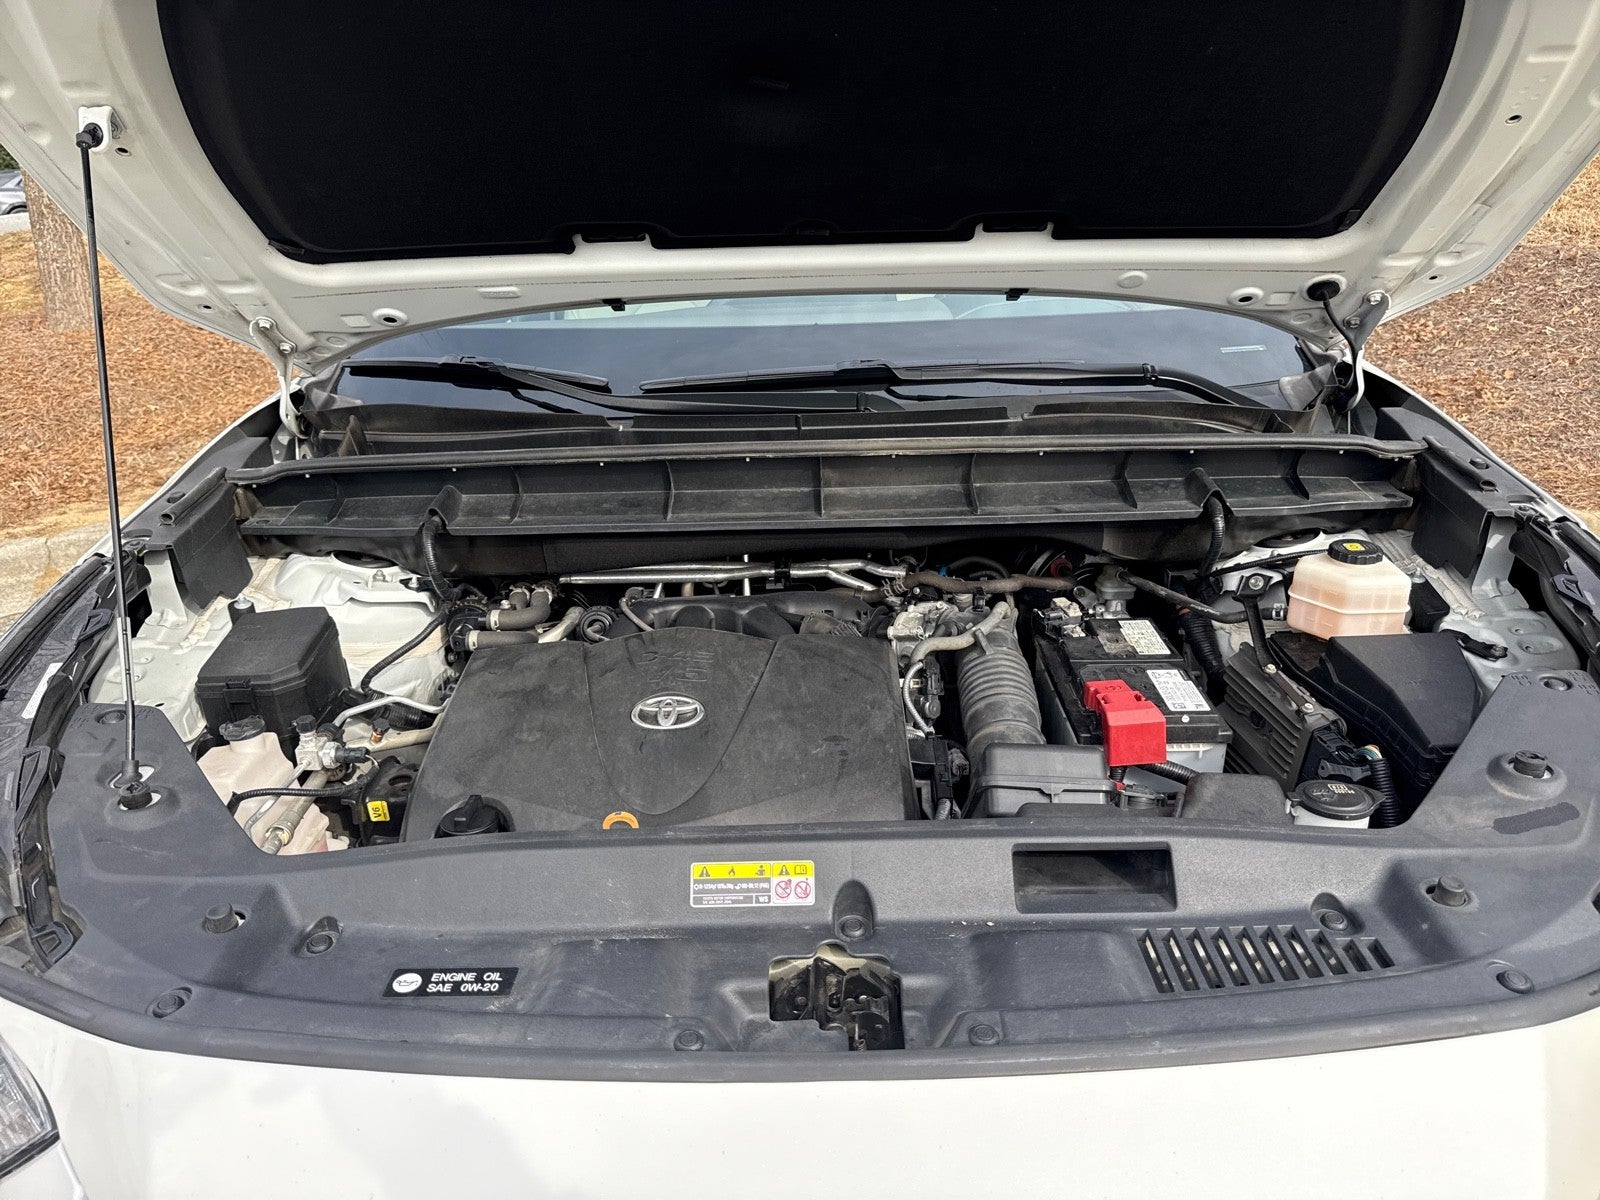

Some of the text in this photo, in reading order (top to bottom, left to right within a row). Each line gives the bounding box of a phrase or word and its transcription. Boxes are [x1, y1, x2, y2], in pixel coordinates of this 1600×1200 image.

[372, 807, 382, 818] V6
[431, 972, 503, 981] ENGINE OIL
[427, 982, 499, 992] SAE 0W-20
